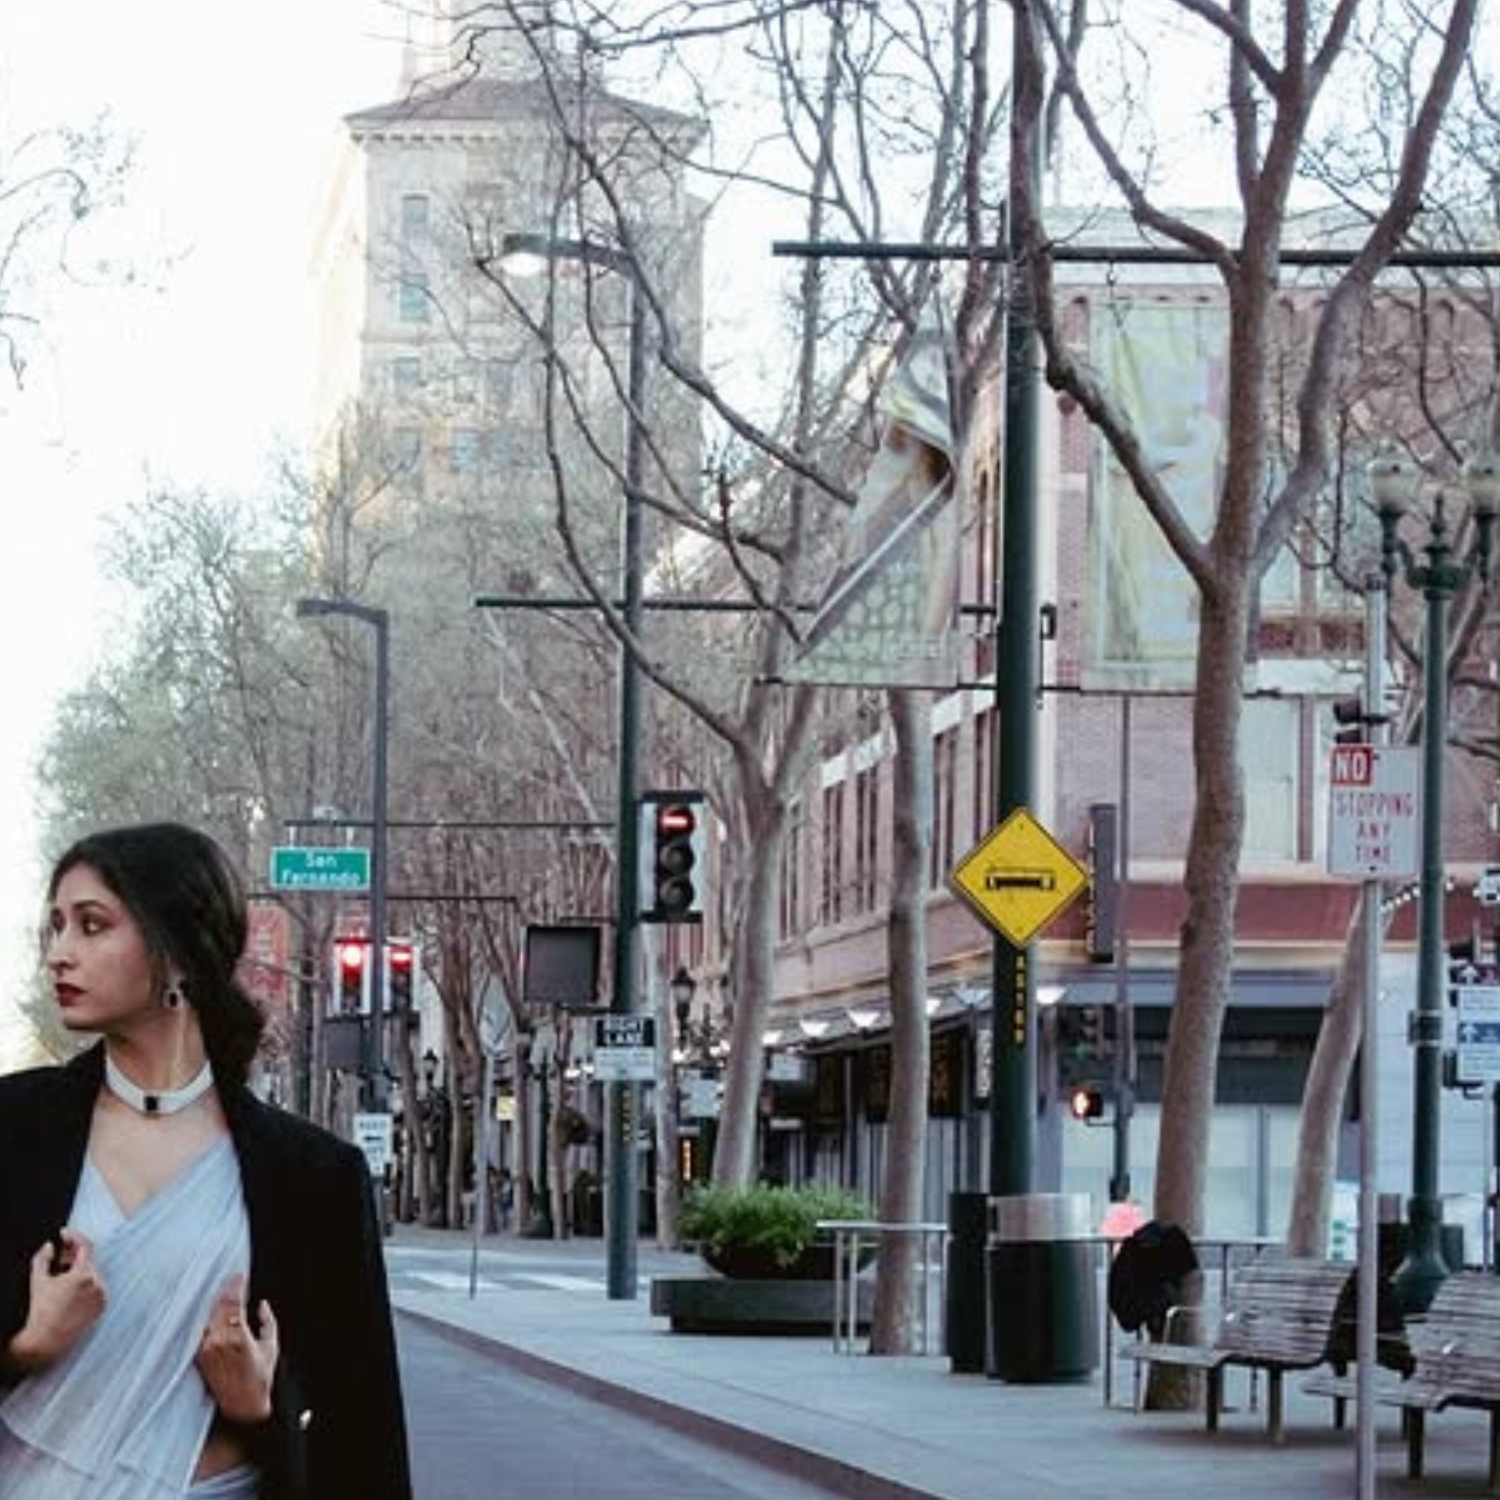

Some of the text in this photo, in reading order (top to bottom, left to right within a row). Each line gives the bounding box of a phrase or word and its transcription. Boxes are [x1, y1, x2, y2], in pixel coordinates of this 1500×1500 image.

[1336, 751, 1368, 782] NO
[1336, 792, 1414, 817] STOPPING
[1356, 822, 1391, 838] ANY
[306, 851, 338, 868] San
[1356, 845, 1391, 864] TIME
[282, 869, 361, 888] Fernando
